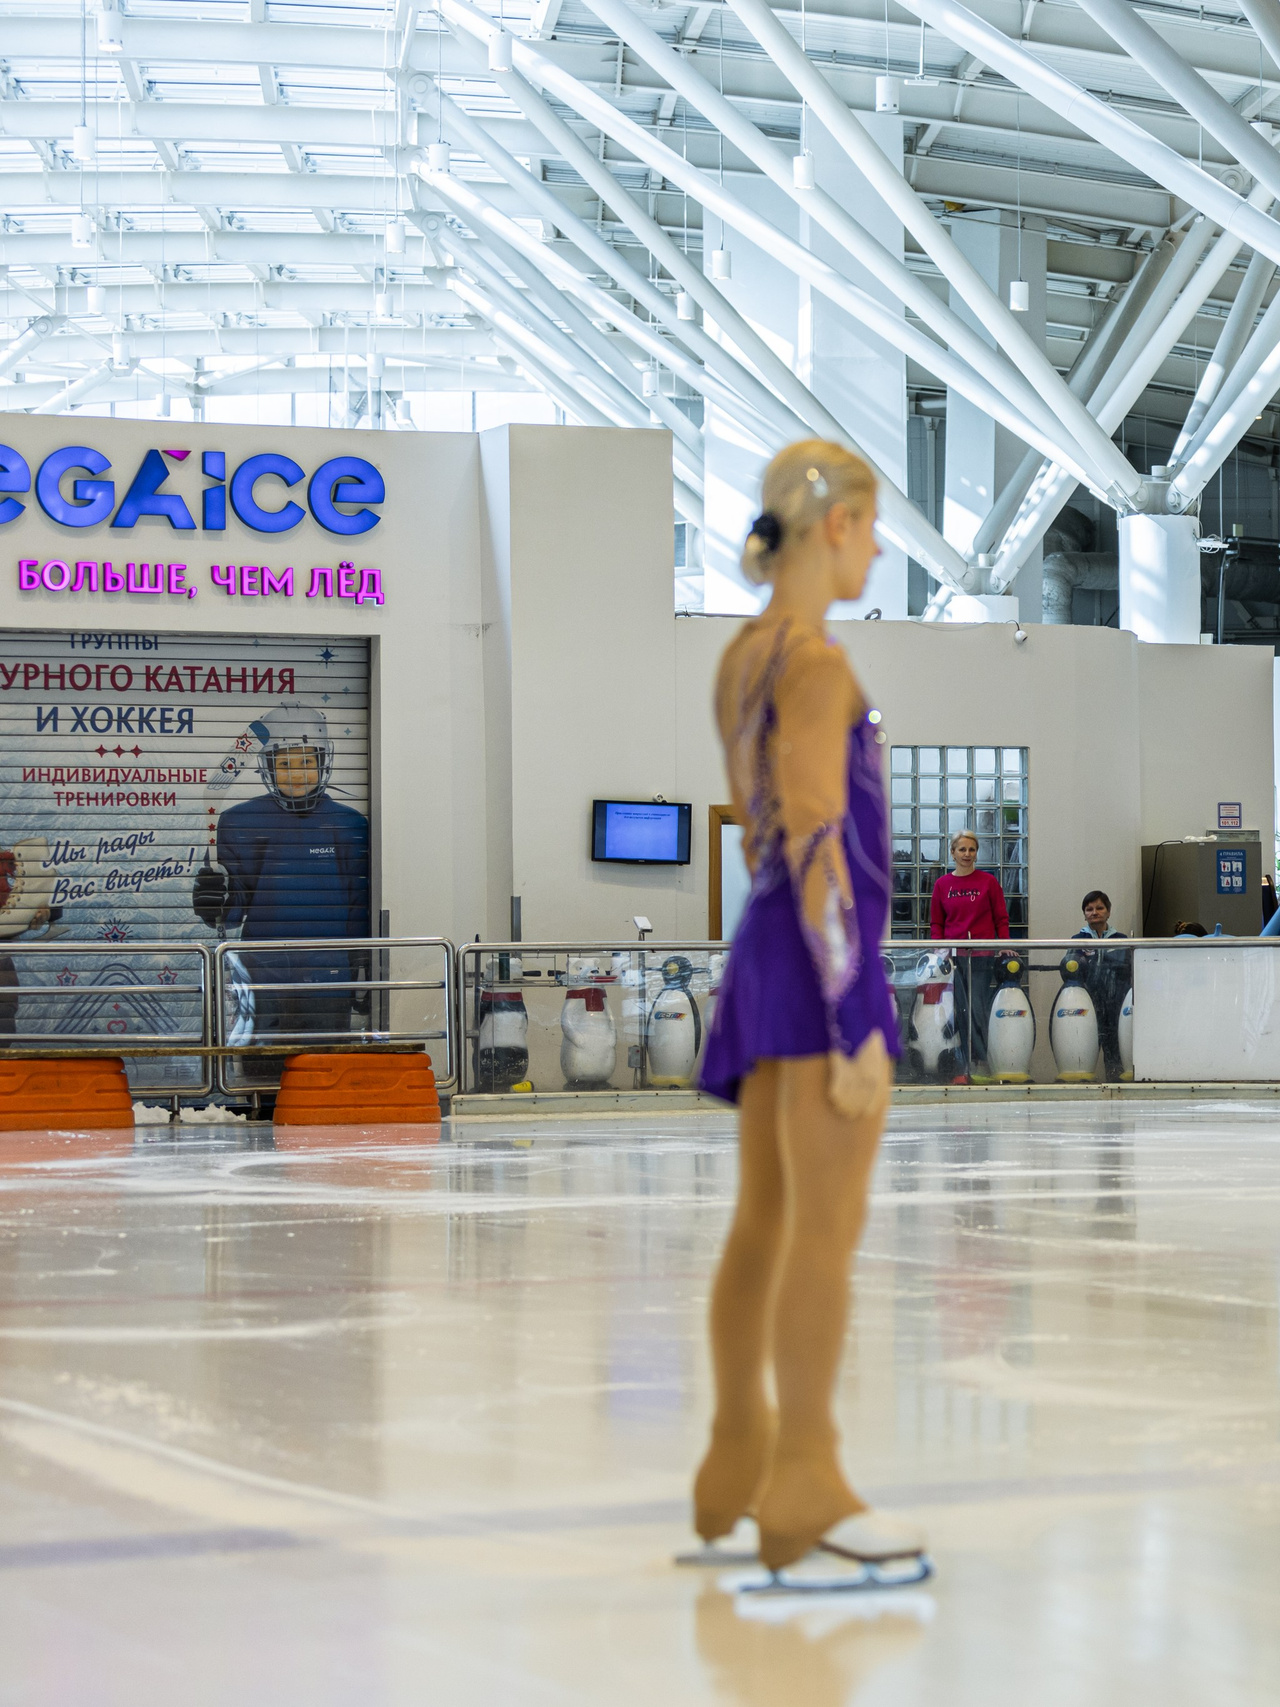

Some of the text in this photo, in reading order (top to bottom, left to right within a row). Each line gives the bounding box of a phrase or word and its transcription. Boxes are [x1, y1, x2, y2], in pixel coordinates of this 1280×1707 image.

[18, 559, 385, 605] БОЛЬШЕ, ЧЕМ ЛЁД
[145, 665, 295, 695] КАТАНИЯ
[36, 706, 195, 734] И ХОККЕЯ
[22, 767, 208, 786] ИНДИВИДУАЛЬНЫЕ
[54, 791, 176, 807] ТРЕНИРОВКИ
[43, 831, 156, 868] Мы рады
[51, 848, 195, 904] Вас видеть!
